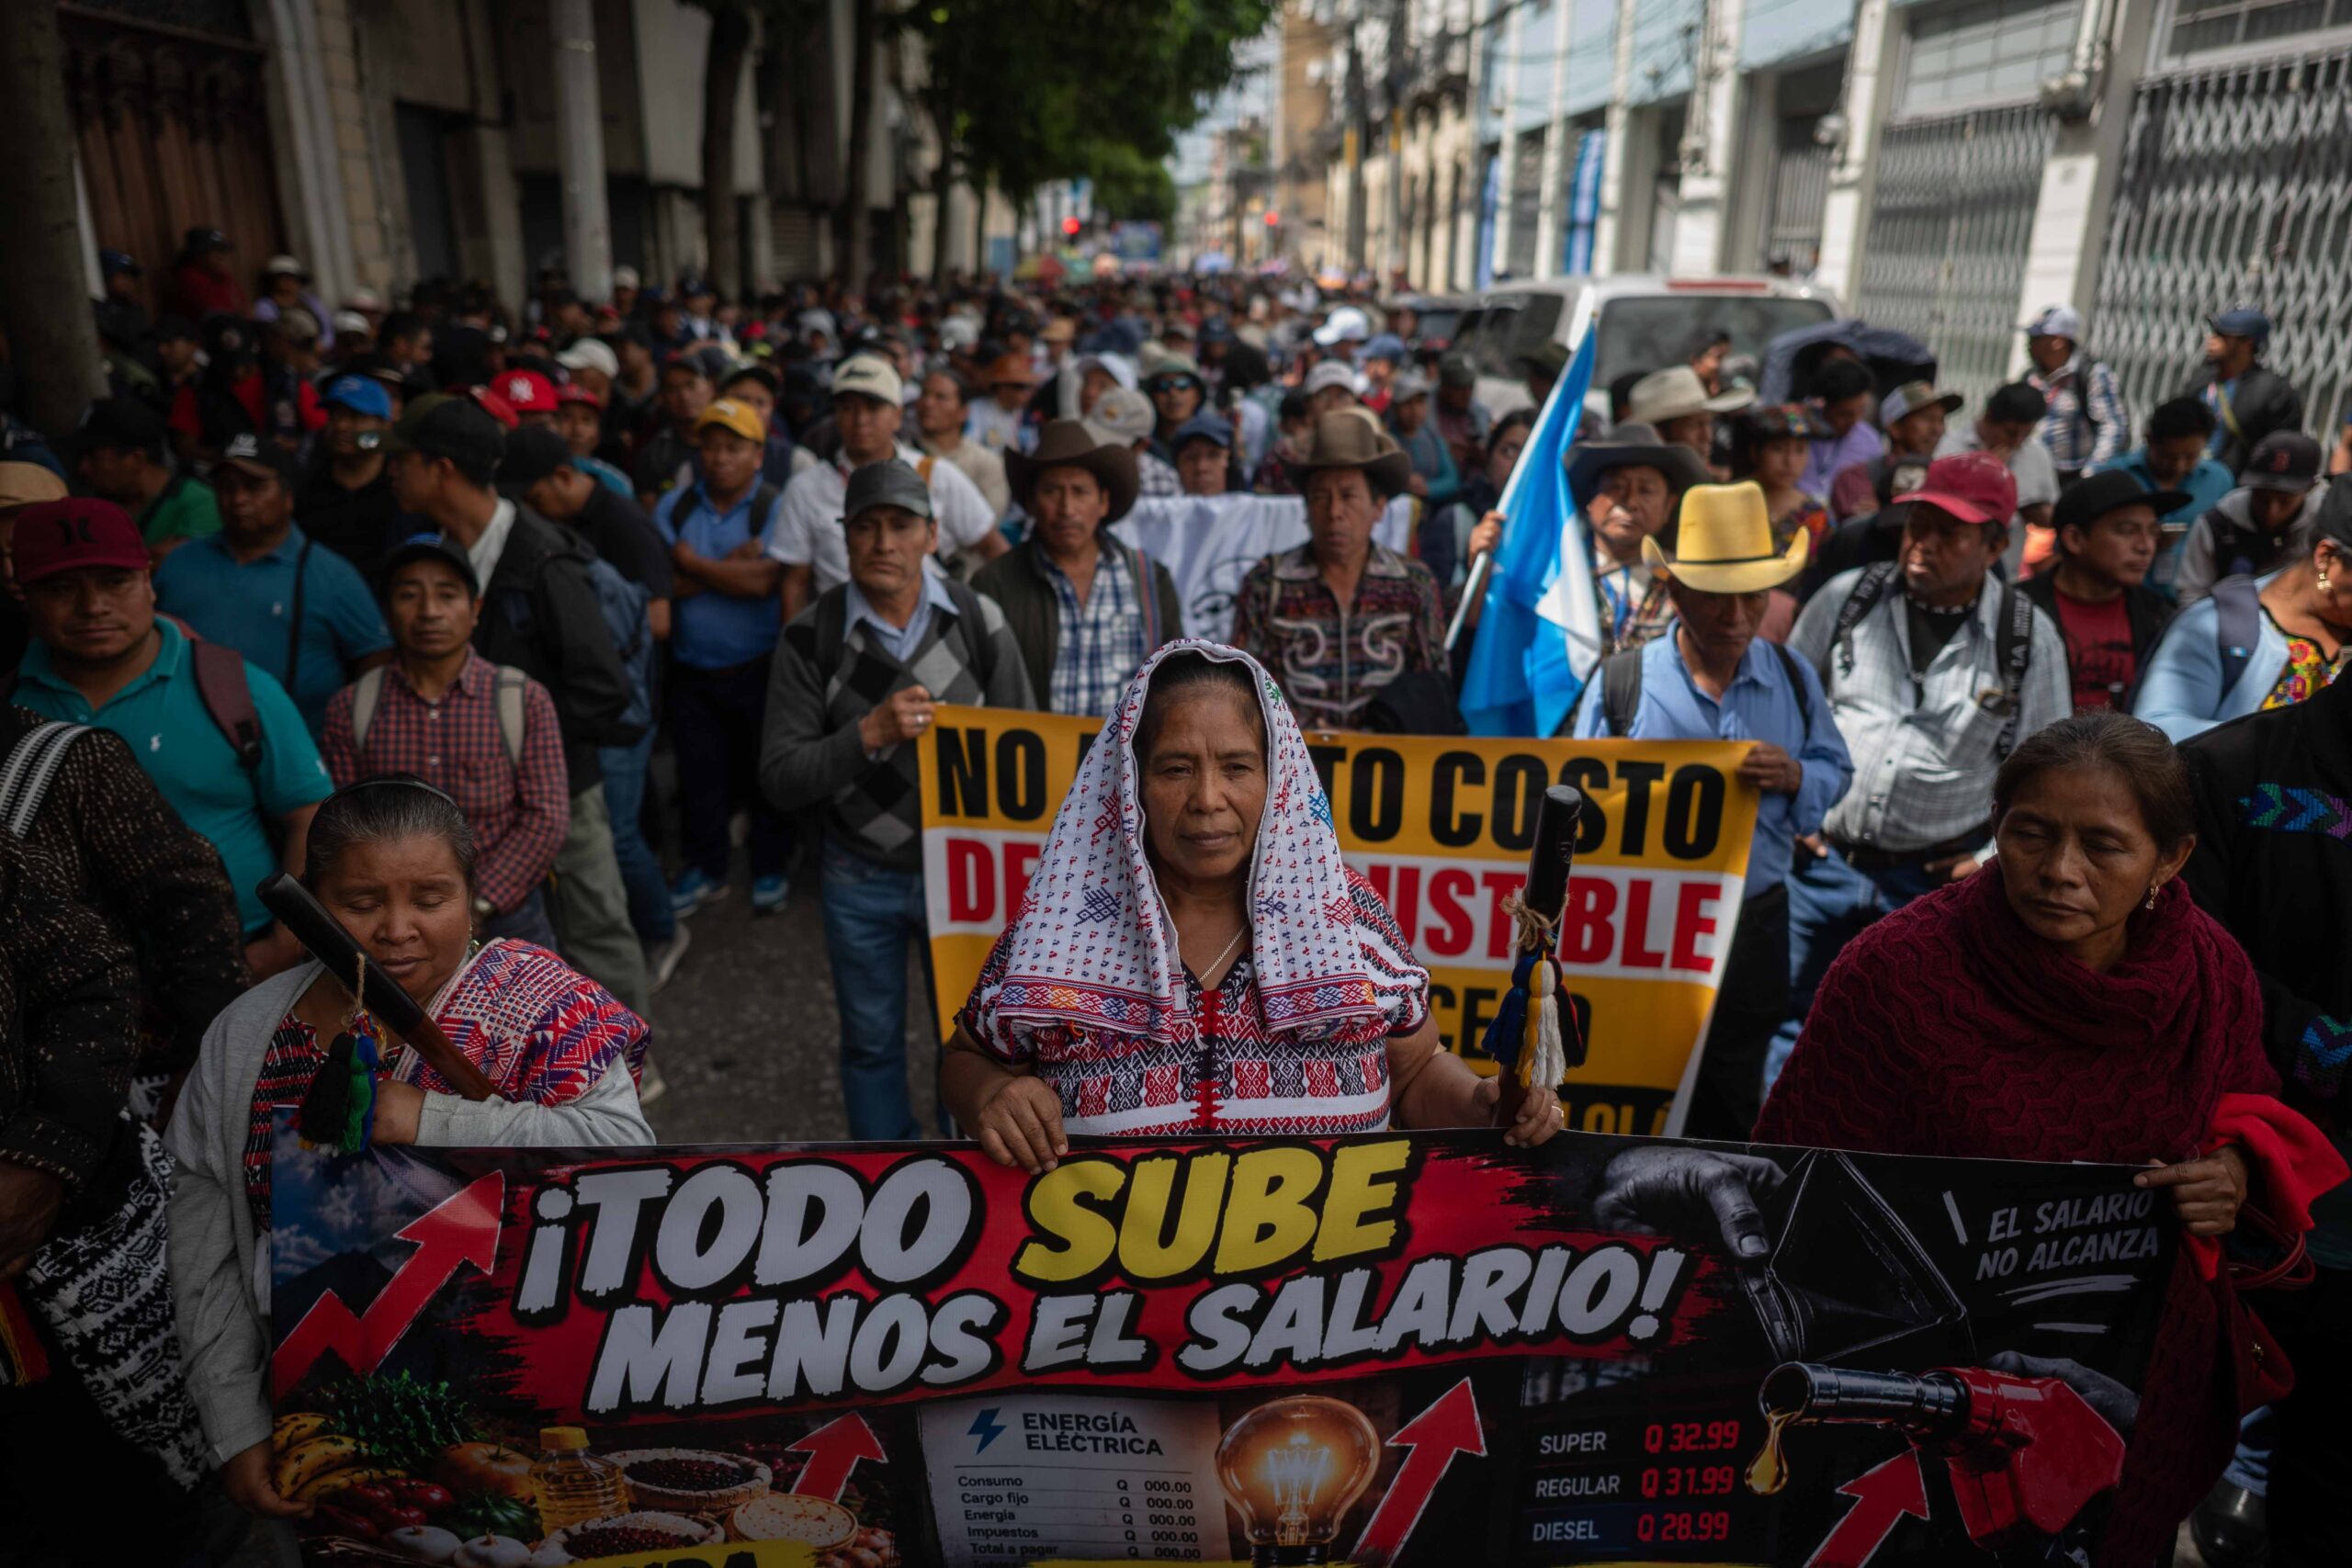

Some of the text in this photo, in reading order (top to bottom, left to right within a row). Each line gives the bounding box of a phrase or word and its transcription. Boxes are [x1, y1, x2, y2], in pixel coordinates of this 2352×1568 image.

[935, 727, 1046, 822] NO
[1429, 750, 1726, 860] COSTO
[517, 1140, 1411, 1314] ¡TODO SUBE
[1988, 1191, 2154, 1241] EL SALARIO
[1975, 1226, 2159, 1281] NO ALCANZA
[587, 1247, 1685, 1416] MENOS EL SALARIO!
[1023, 1411, 1138, 1434] ENERGÍA
[1540, 1420, 1740, 1454] SUPER Q 32.99
[1026, 1431, 1165, 1456] ELÉCTRICA
[957, 1475, 1192, 1494] Consumo Q 000.00
[1535, 1466, 1735, 1499] REGULAR Q 31.99
[961, 1492, 1193, 1510] Cargo fijo Q 000.00
[964, 1508, 1196, 1527] Energía Q 000.00
[1532, 1512, 1730, 1542] DIESEL Q 28.99
[967, 1527, 1198, 1543] Impuestos Q 000.00
[970, 1543, 1202, 1560] Total a pagar Q 000.00
